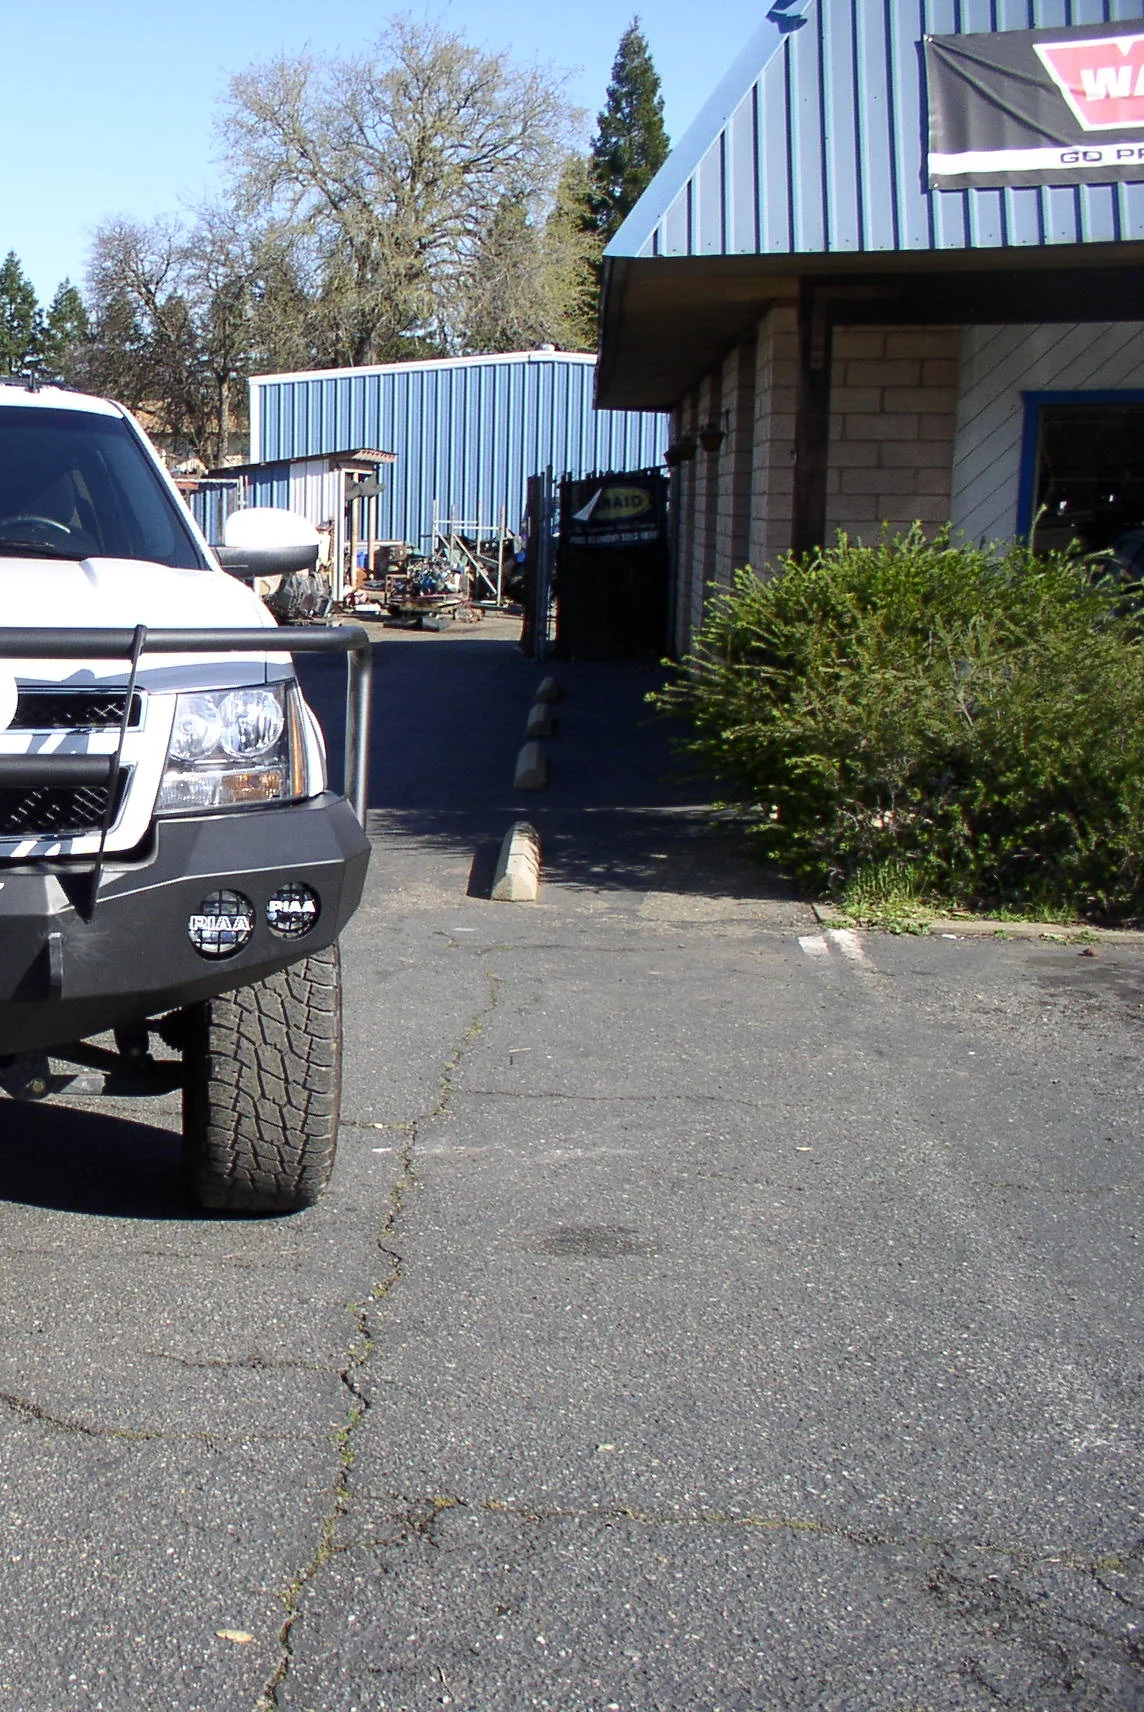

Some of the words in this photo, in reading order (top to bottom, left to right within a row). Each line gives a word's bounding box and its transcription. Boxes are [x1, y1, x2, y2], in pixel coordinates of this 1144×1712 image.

[1080, 63, 1144, 101] W
[1060, 150, 1103, 164] GO
[268, 900, 316, 913] PIAA
[189, 915, 252, 931] PIAA
